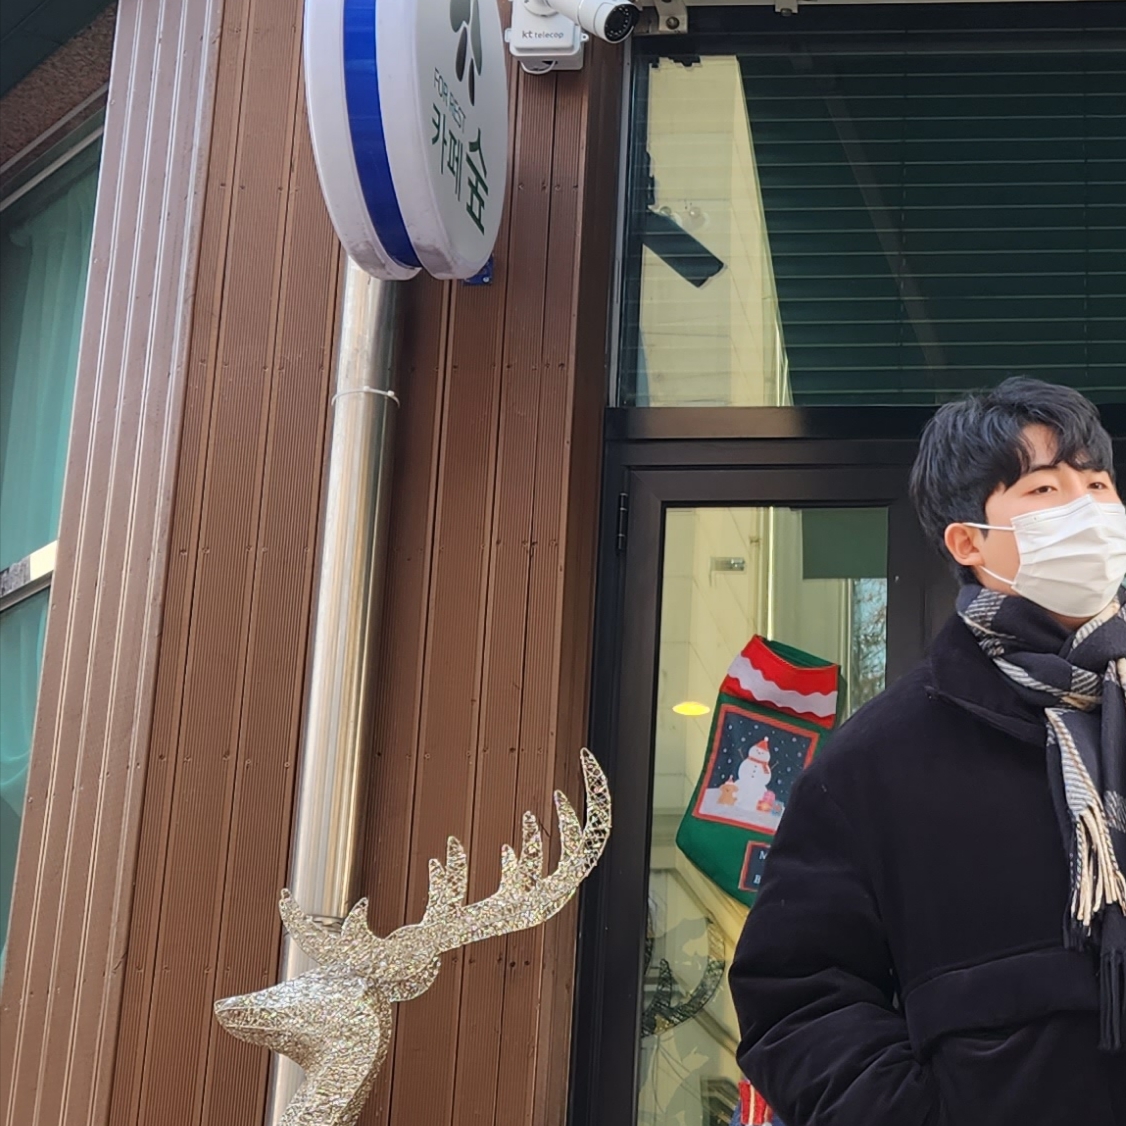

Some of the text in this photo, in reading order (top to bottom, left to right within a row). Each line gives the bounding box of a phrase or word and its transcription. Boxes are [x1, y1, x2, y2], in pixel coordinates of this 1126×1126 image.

[522, 30, 564, 39] kt telecop
[432, 102, 463, 202] 카페
